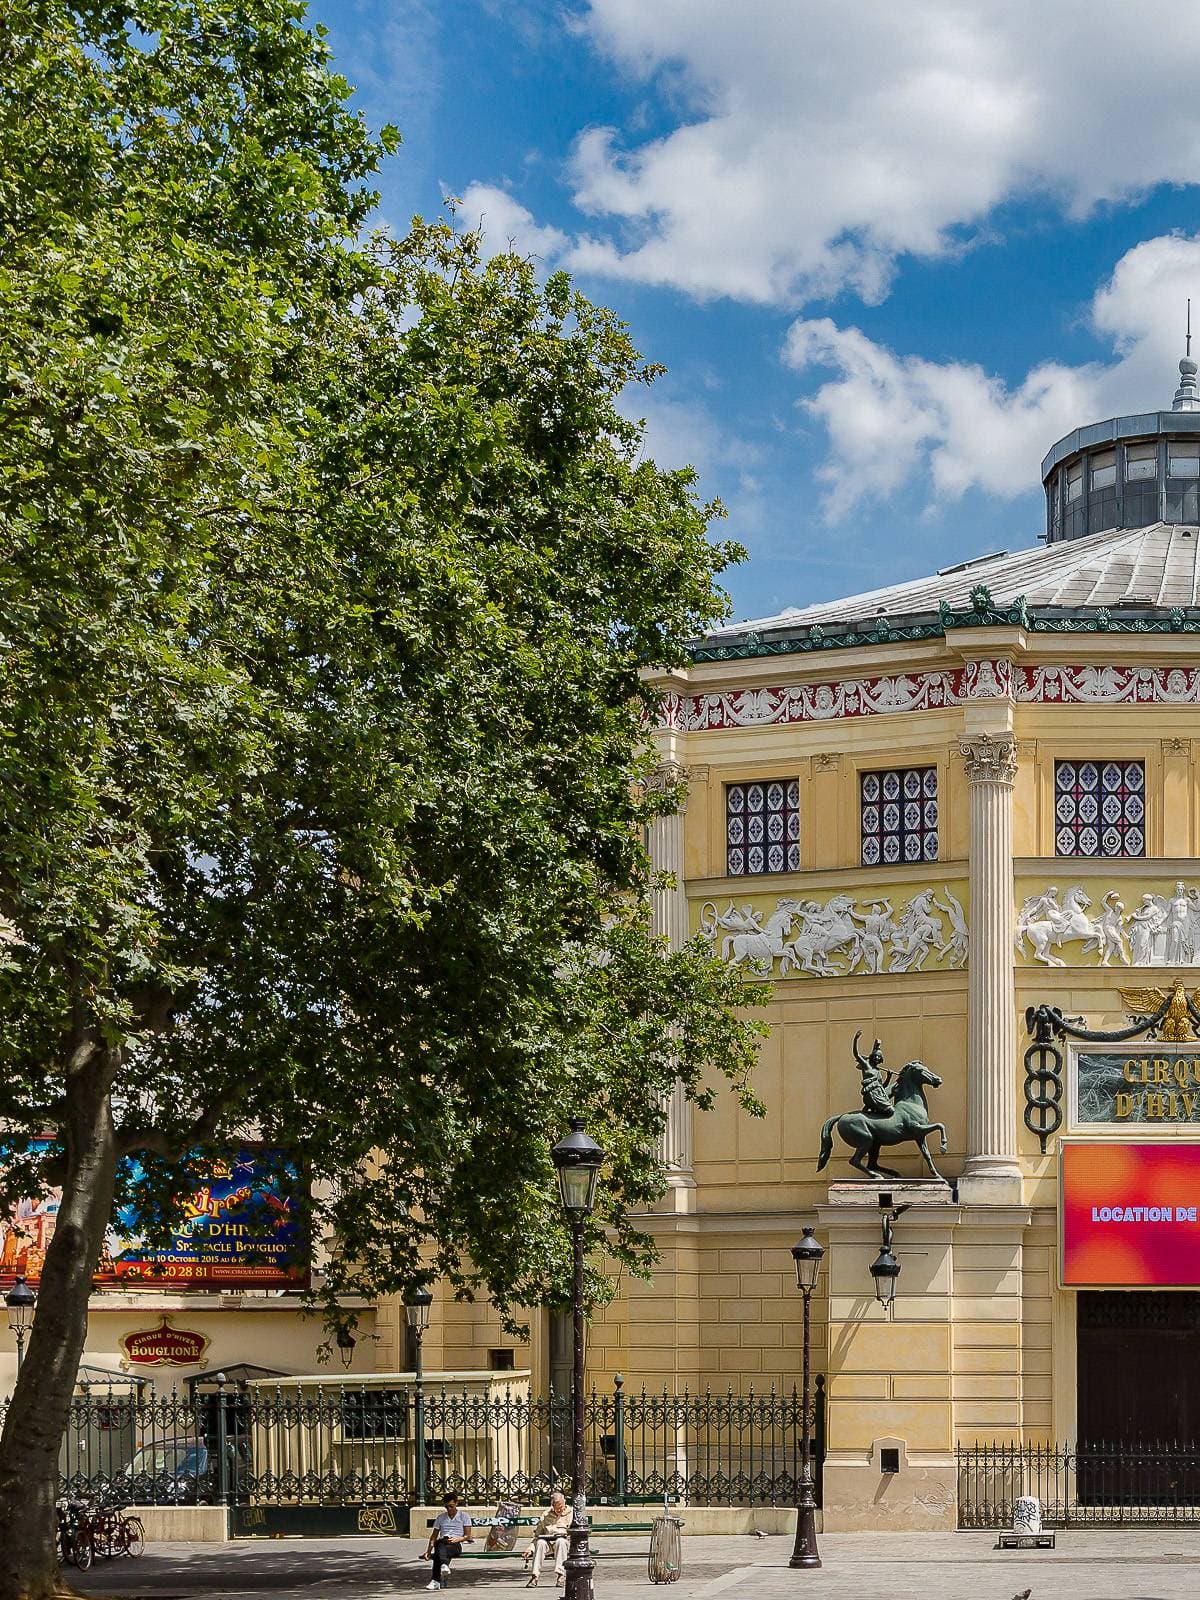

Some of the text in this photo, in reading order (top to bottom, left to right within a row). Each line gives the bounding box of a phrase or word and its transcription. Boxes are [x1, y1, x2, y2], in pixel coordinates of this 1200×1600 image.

[1091, 1207, 1173, 1222] LOCATION
[1175, 1207, 1198, 1222] DE
[209, 1223, 274, 1236] D'HI
[176, 1240, 232, 1252] SPTACLE
[178, 1266, 192, 1276] 28
[195, 1266, 207, 1276] 81
[134, 1332, 196, 1345] CIRQUE D'HIVER
[131, 1346, 199, 1356] BOUGLIONE
